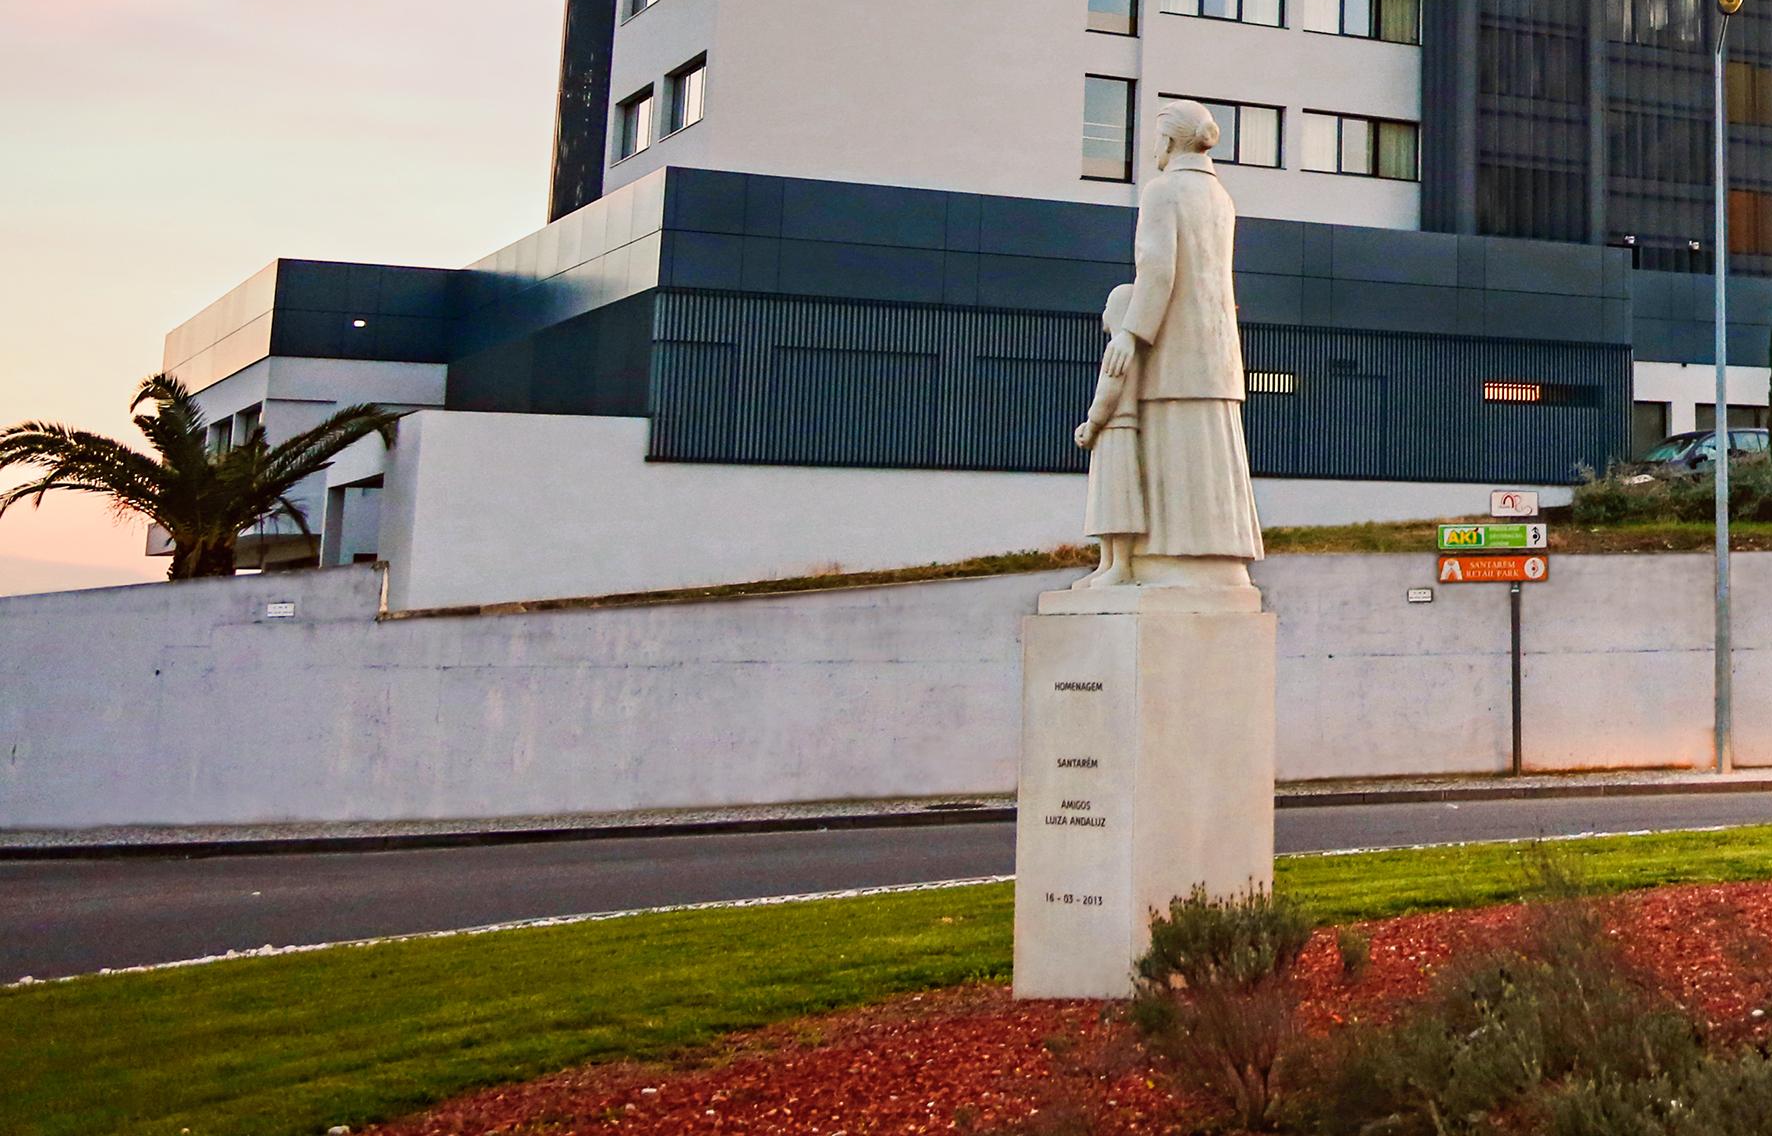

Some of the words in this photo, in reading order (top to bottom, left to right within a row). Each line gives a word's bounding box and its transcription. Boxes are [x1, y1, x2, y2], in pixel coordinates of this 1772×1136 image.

[1466, 569, 1494, 577] RETAIL
[1496, 568, 1520, 577] PARK
[1054, 681, 1103, 692] HOMENAGEM
[1061, 799, 1091, 811] AMIGOS
[1045, 815, 1068, 825] LUIZA
[1069, 816, 1106, 828] ANDALUZ
[1063, 893, 1074, 904] 03
